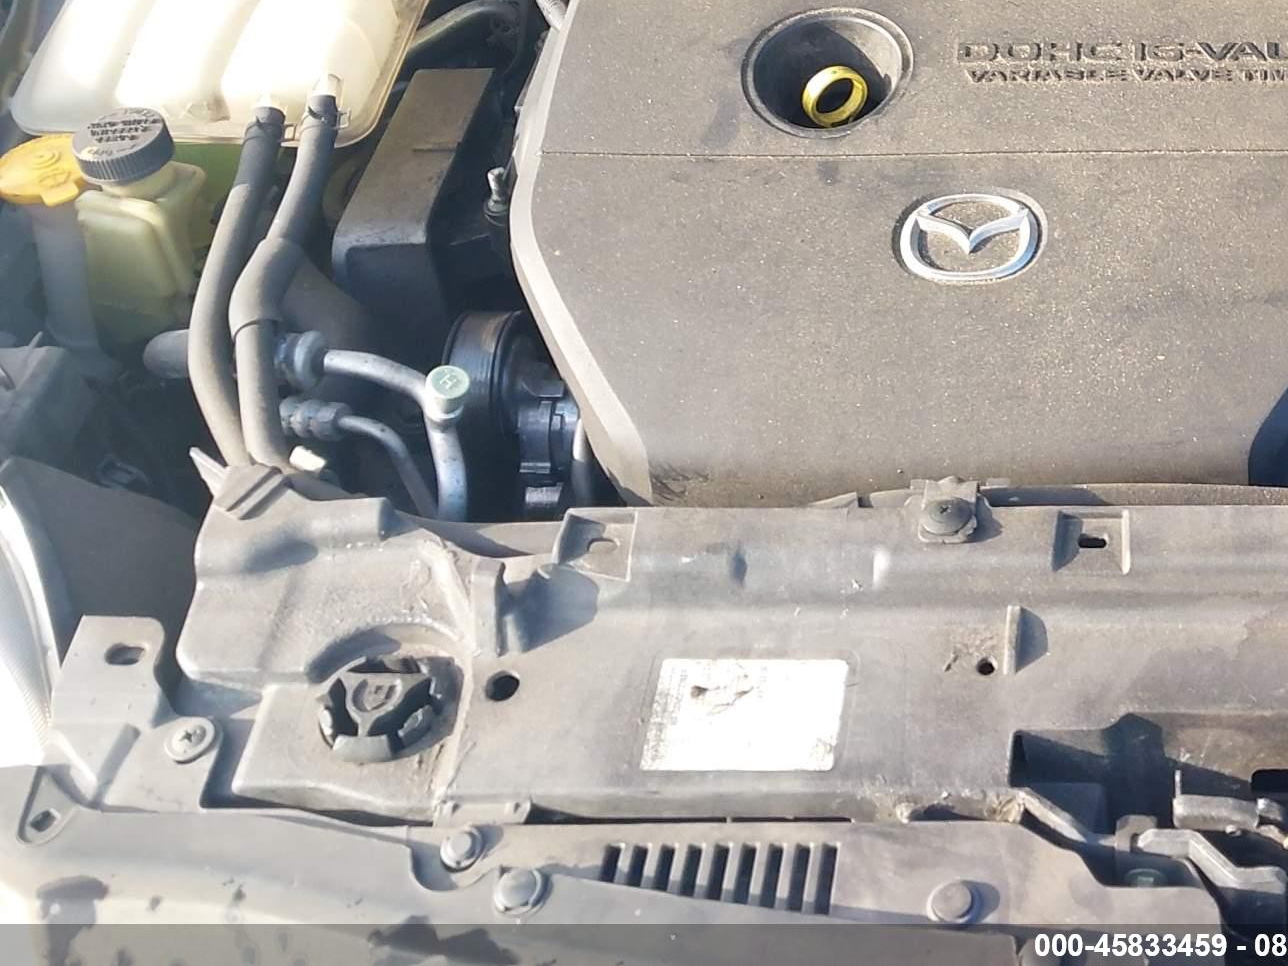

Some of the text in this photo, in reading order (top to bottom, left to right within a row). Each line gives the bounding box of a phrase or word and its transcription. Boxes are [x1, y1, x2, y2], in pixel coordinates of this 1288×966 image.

[956, 40, 1124, 63] DOHC
[965, 67, 1128, 84] VARIABLE
[1133, 67, 1233, 84] VALVE
